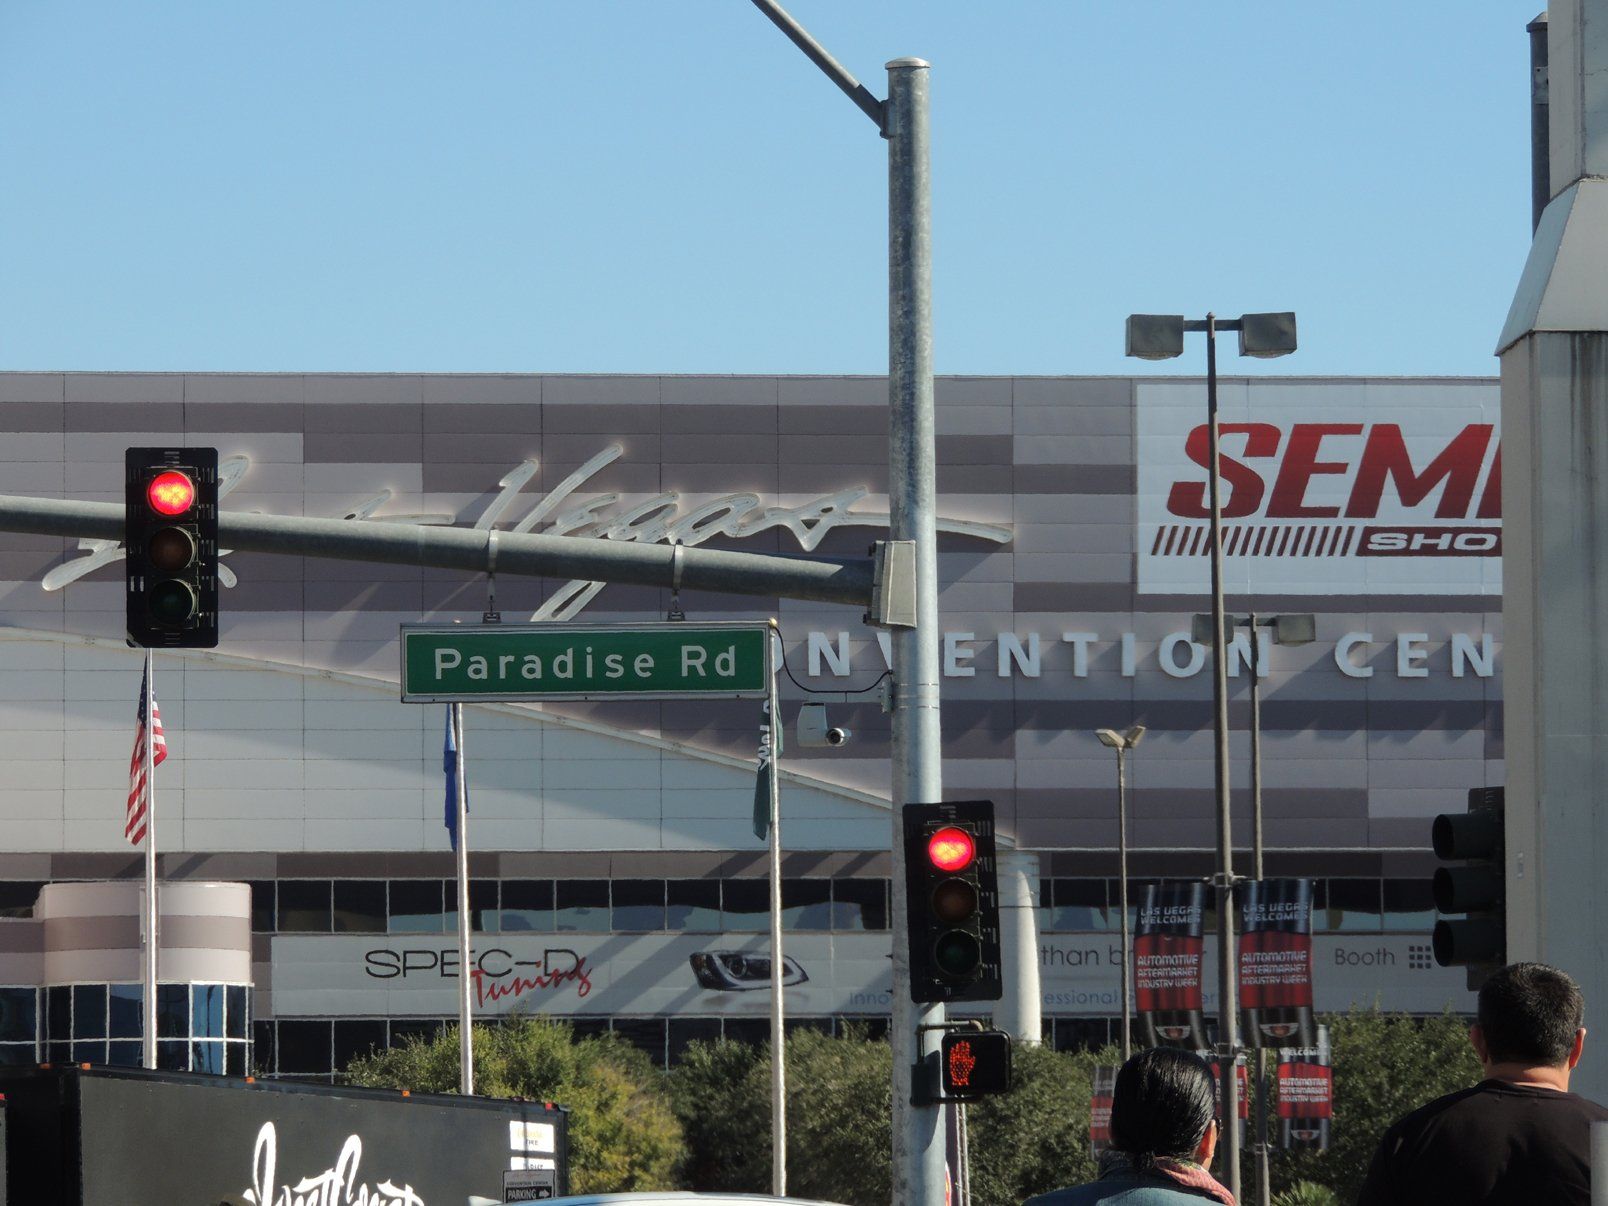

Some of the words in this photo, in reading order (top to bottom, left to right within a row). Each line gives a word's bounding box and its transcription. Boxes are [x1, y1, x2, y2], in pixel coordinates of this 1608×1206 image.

[1167, 423, 1502, 519] SEM
[434, 646, 655, 680] Paradise
[681, 645, 736, 678] Rd
[1140, 906, 1161, 916] LAS
[1242, 903, 1265, 913] LAS
[1140, 914, 1202, 925] WELCOMES
[1243, 911, 1309, 922] WELCOMES
[1041, 945, 1099, 966] than
[1137, 954, 1199, 966] AUTOMOTIVE
[1241, 951, 1307, 963] AUTOMOTIVE
[1335, 948, 1396, 966] Booth
[365, 949, 580, 979] SPEC-D
[1241, 964, 1307, 975] AFTERMARKET
[1137, 967, 1198, 977] AFTERMARKET
[470, 956, 593, 1008] Tuning
[1137, 978, 1174, 988] INDUSTRY
[1174, 978, 1198, 987] WEEK
[1241, 975, 1280, 985] INDUSTRY
[1281, 975, 1308, 984] WEEK
[507, 1189, 537, 1200] PARKING
